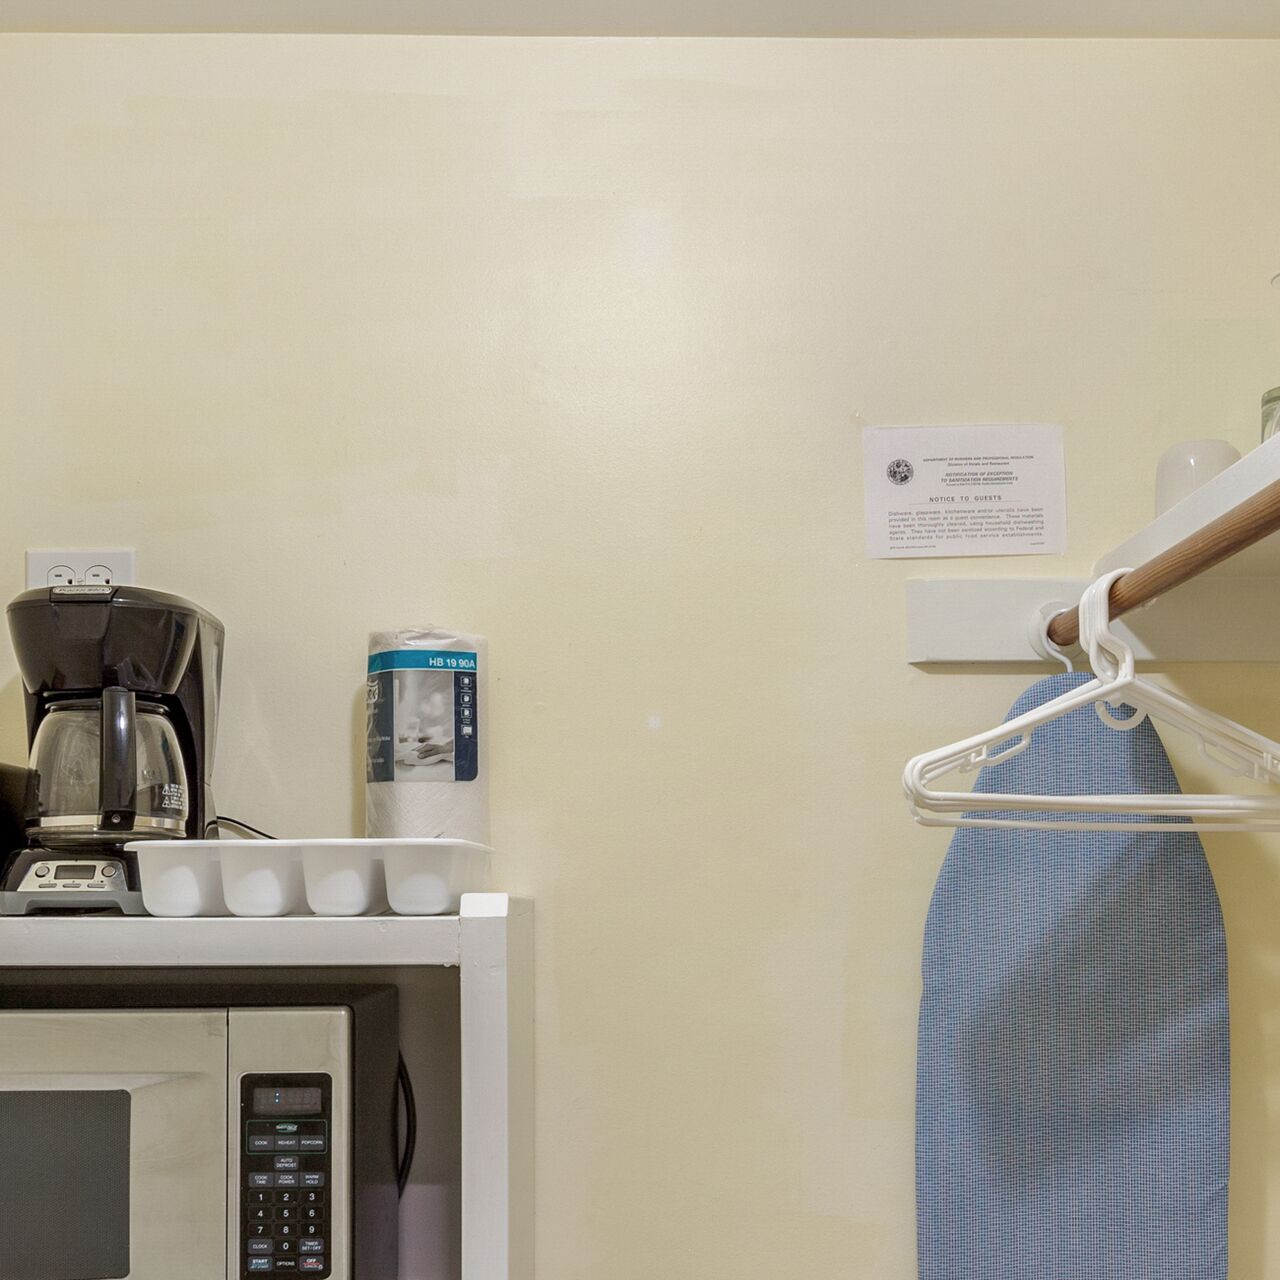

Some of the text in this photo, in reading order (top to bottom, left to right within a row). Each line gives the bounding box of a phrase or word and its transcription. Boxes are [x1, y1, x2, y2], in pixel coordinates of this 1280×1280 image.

[429, 658, 444, 666] HB
[446, 658, 457, 668] 19
[283, 1193, 289, 1201] 2
[283, 1209, 289, 1217] 5
[309, 1209, 315, 1217] 6
[257, 1226, 263, 1234] 7
[283, 1226, 289, 1234] 8
[309, 1226, 315, 1234] 9
[283, 1242, 289, 1250] 0
